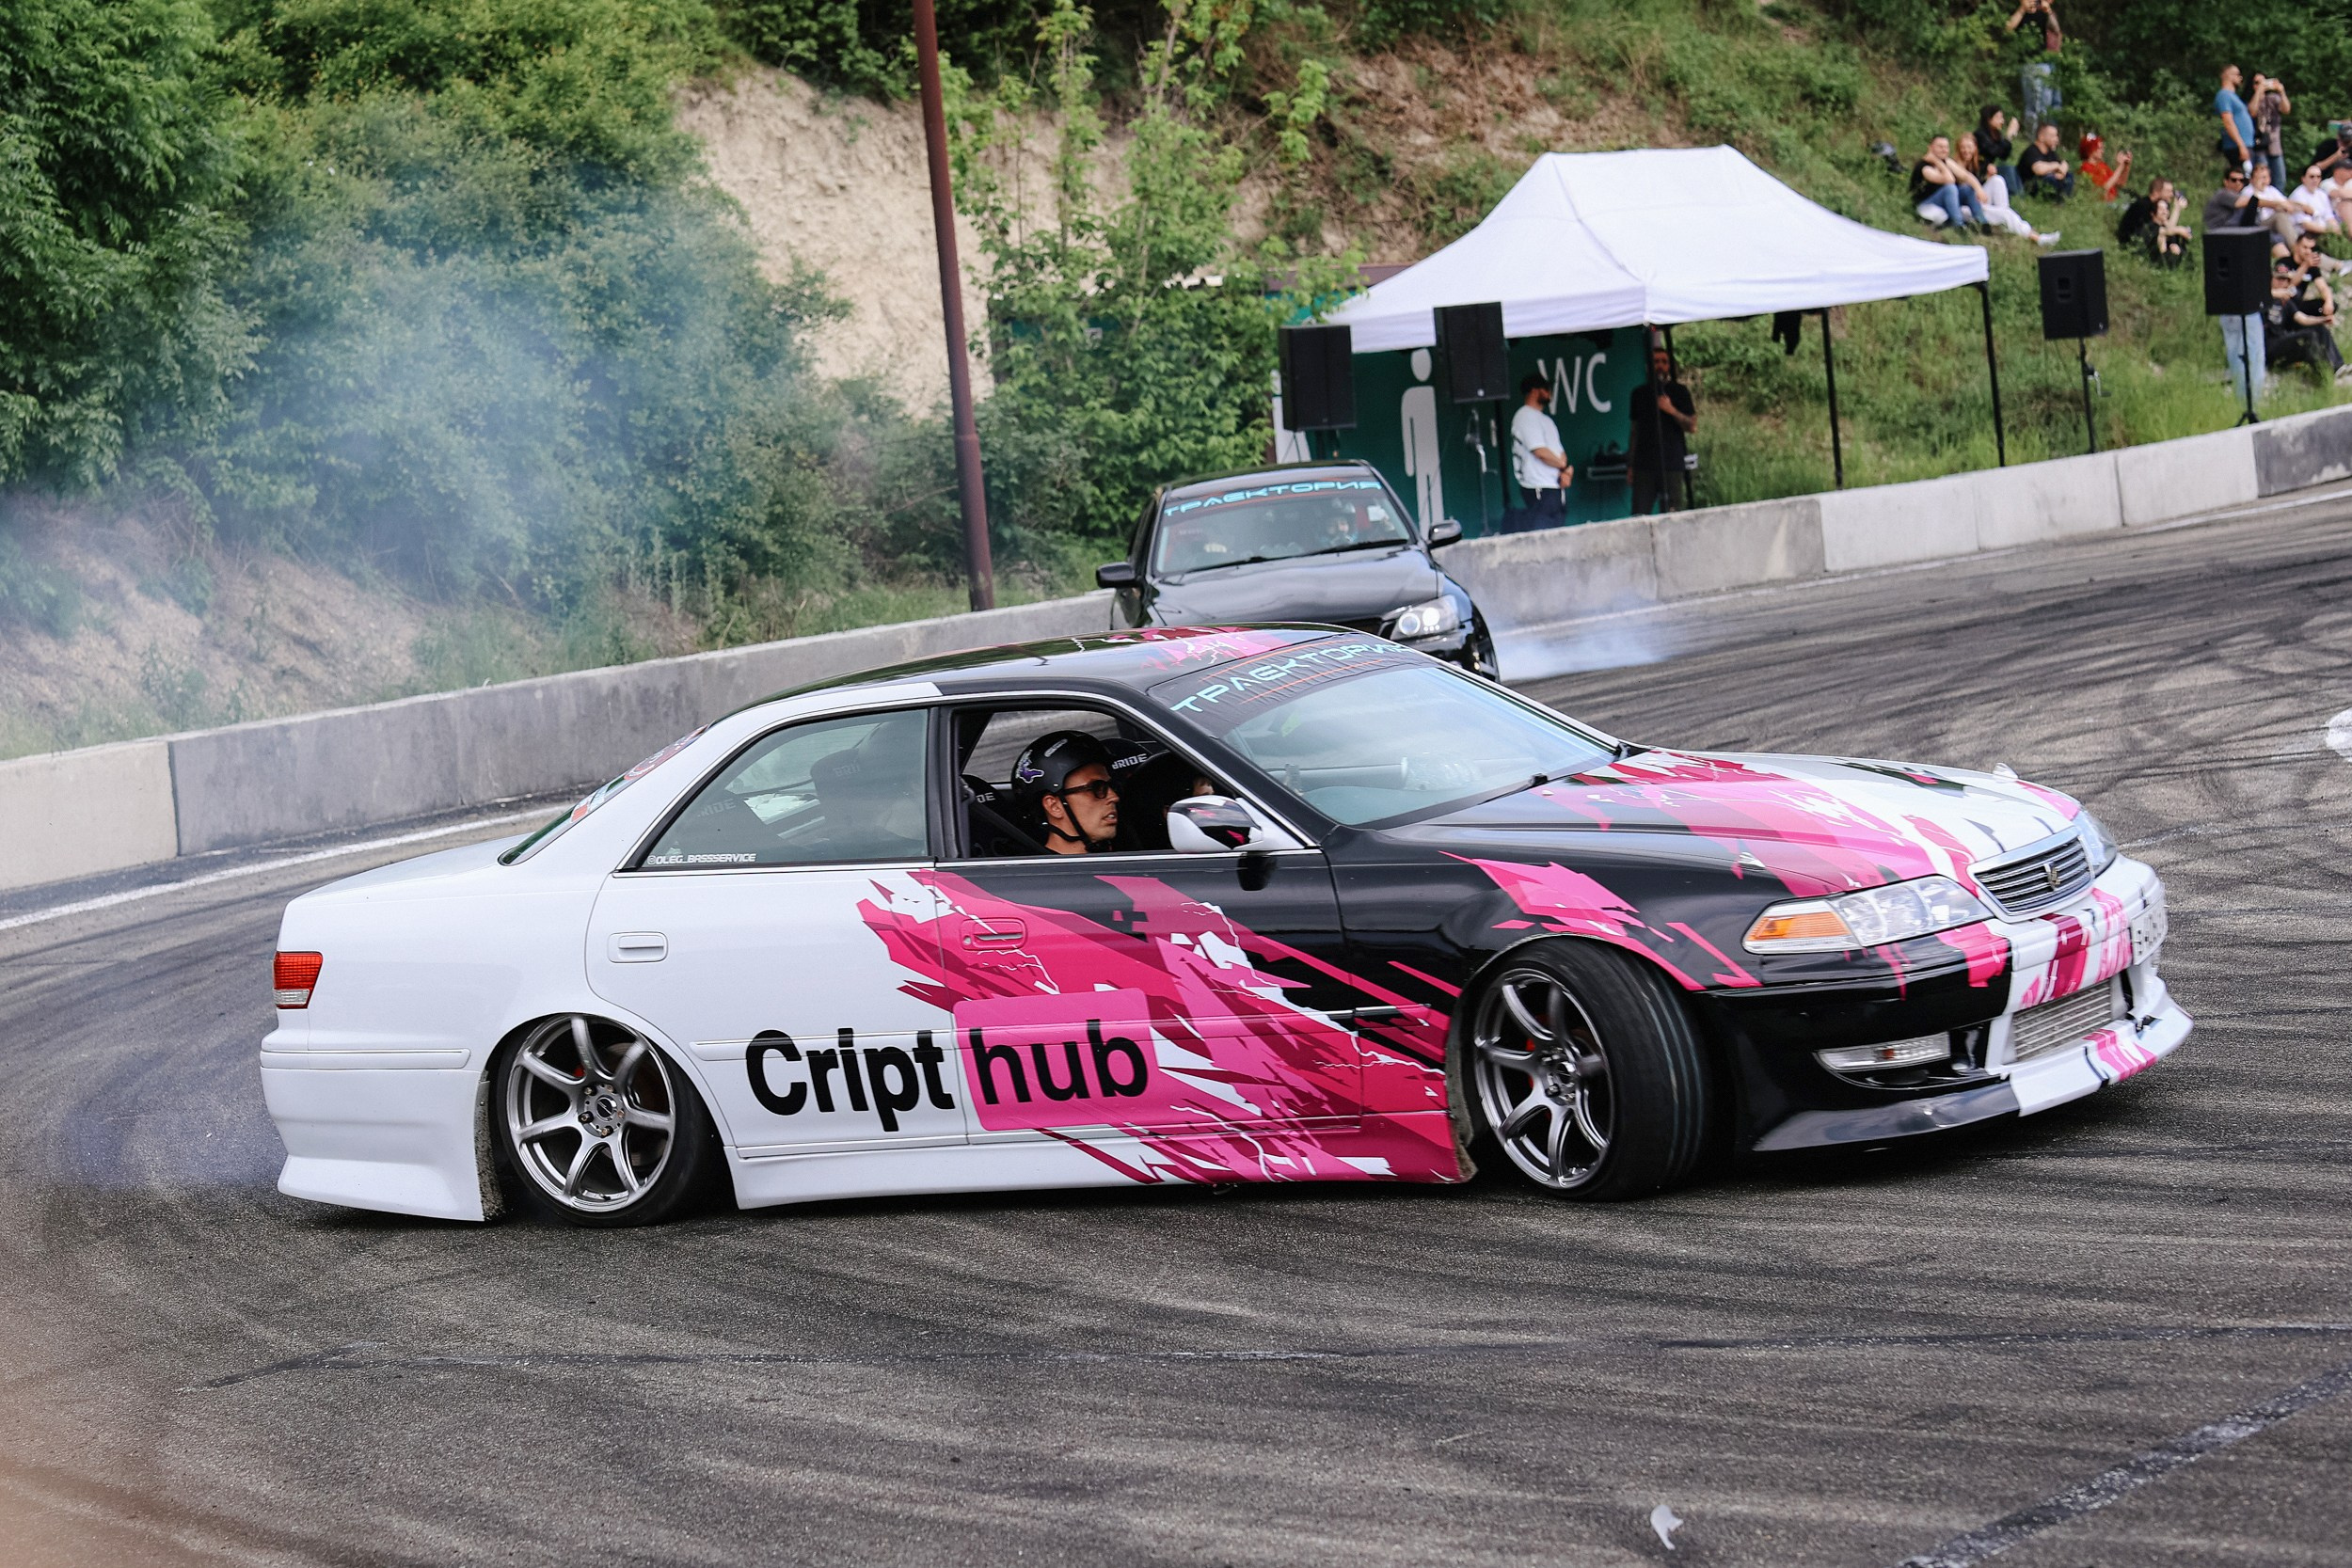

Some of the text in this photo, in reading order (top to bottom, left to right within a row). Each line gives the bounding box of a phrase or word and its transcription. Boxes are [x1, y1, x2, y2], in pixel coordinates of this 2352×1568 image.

[1537, 352, 1613, 416] WC
[1163, 480, 1383, 516] ТРАЕКТОРИЯ
[746, 1019, 1149, 1132] Cript hub
